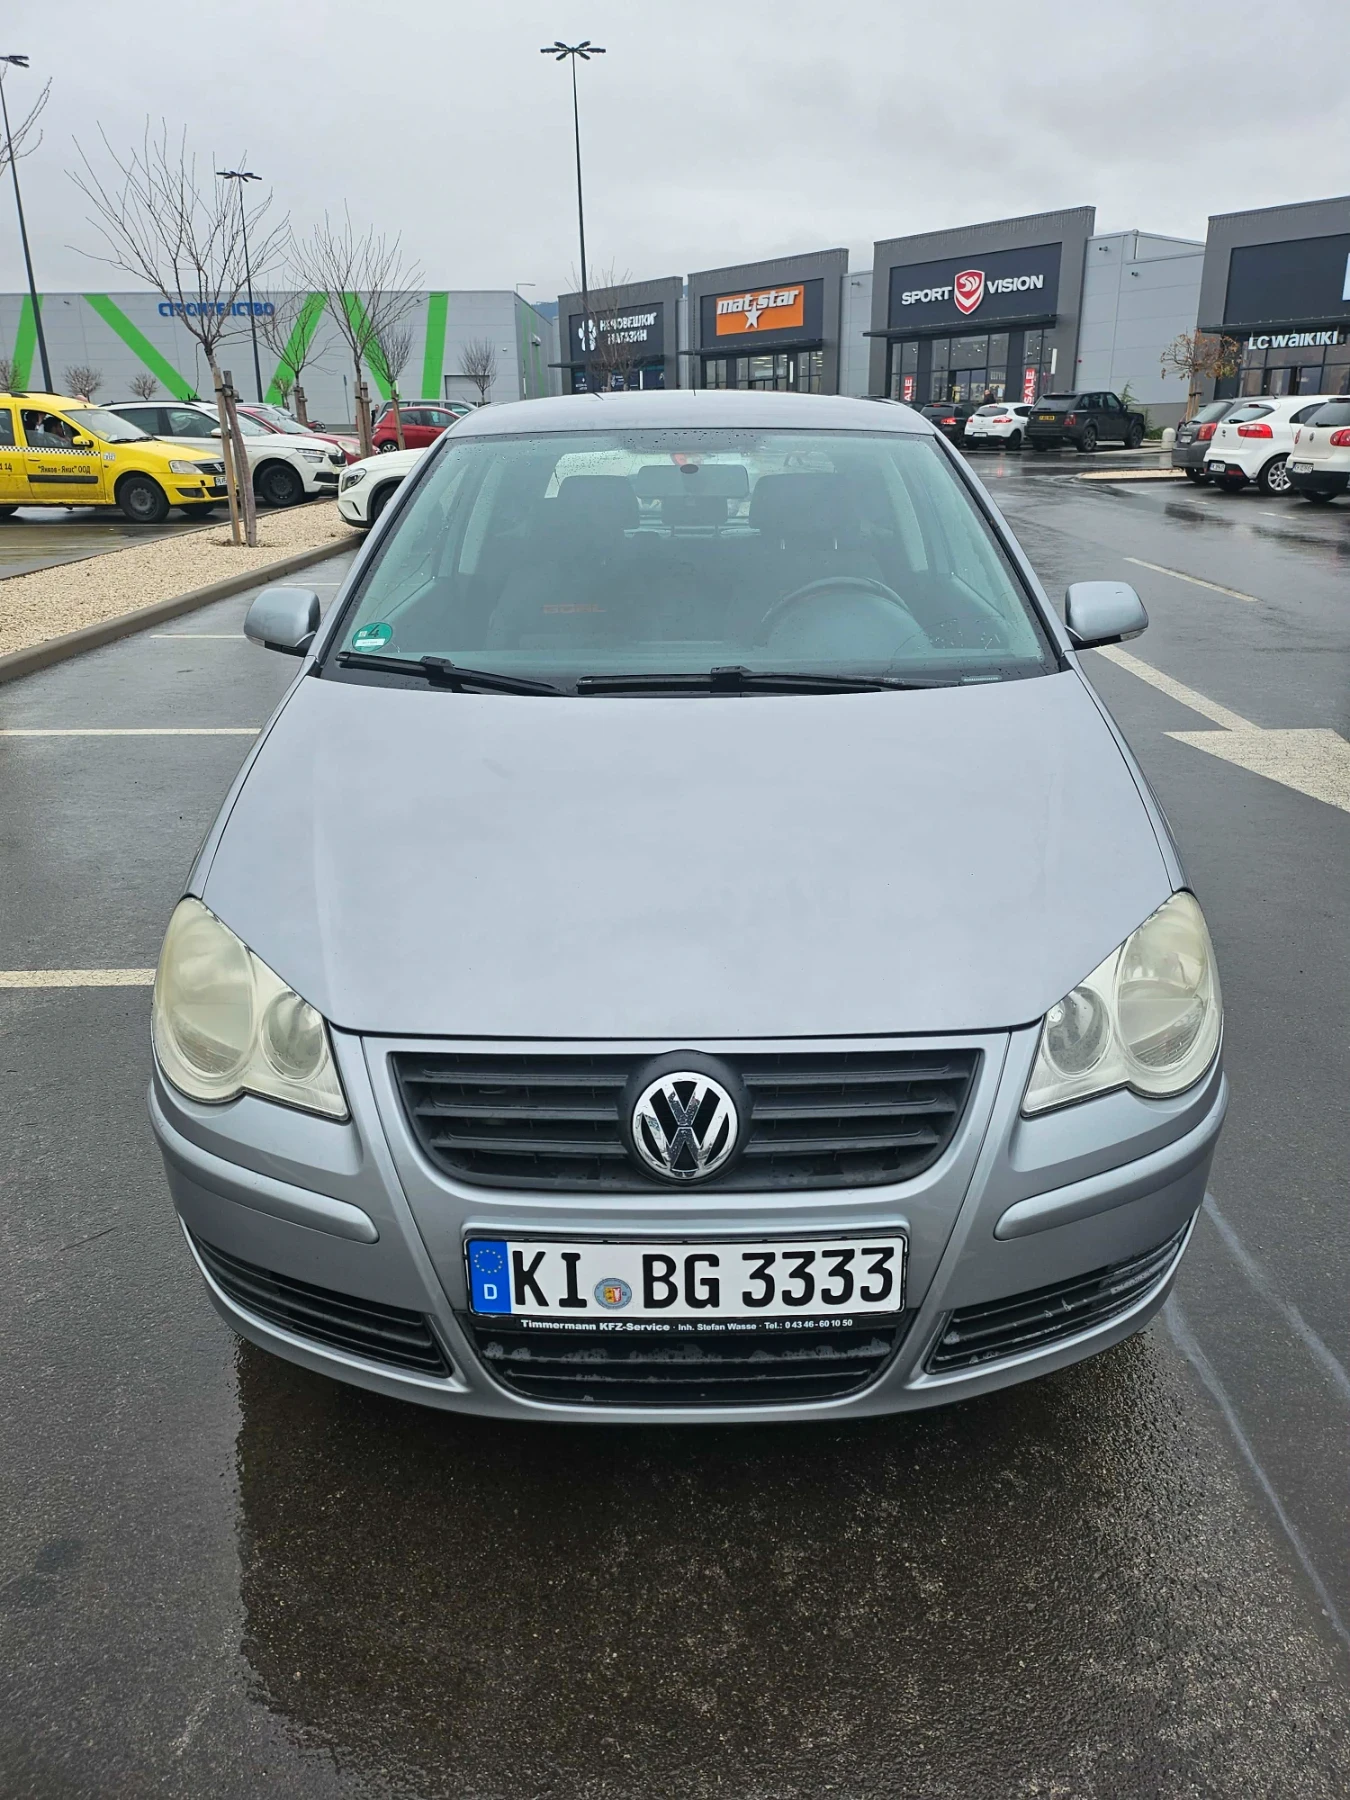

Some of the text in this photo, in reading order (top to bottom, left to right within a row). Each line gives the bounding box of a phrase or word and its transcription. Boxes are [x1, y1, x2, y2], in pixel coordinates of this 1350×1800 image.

[901, 274, 1044, 305] SPORT VISION
[717, 289, 799, 315] mat star
[1248, 335, 1269, 350] LC
[904, 378, 913, 402] ALE
[1023, 370, 1035, 405] SALE
[368, 624, 380, 638] 4
[512, 1250, 588, 1308] KI
[642, 1253, 720, 1309] BG
[742, 1246, 895, 1309] 3333
[483, 1283, 498, 1300] D
[520, 1319, 597, 1331] Timmermann
[599, 1322, 670, 1331] KFZ-Service
[678, 1323, 695, 1331] Inh.
[697, 1323, 726, 1331] Stefan
[764, 1321, 783, 1330] Tel.:
[842, 1318, 853, 1327] 50
